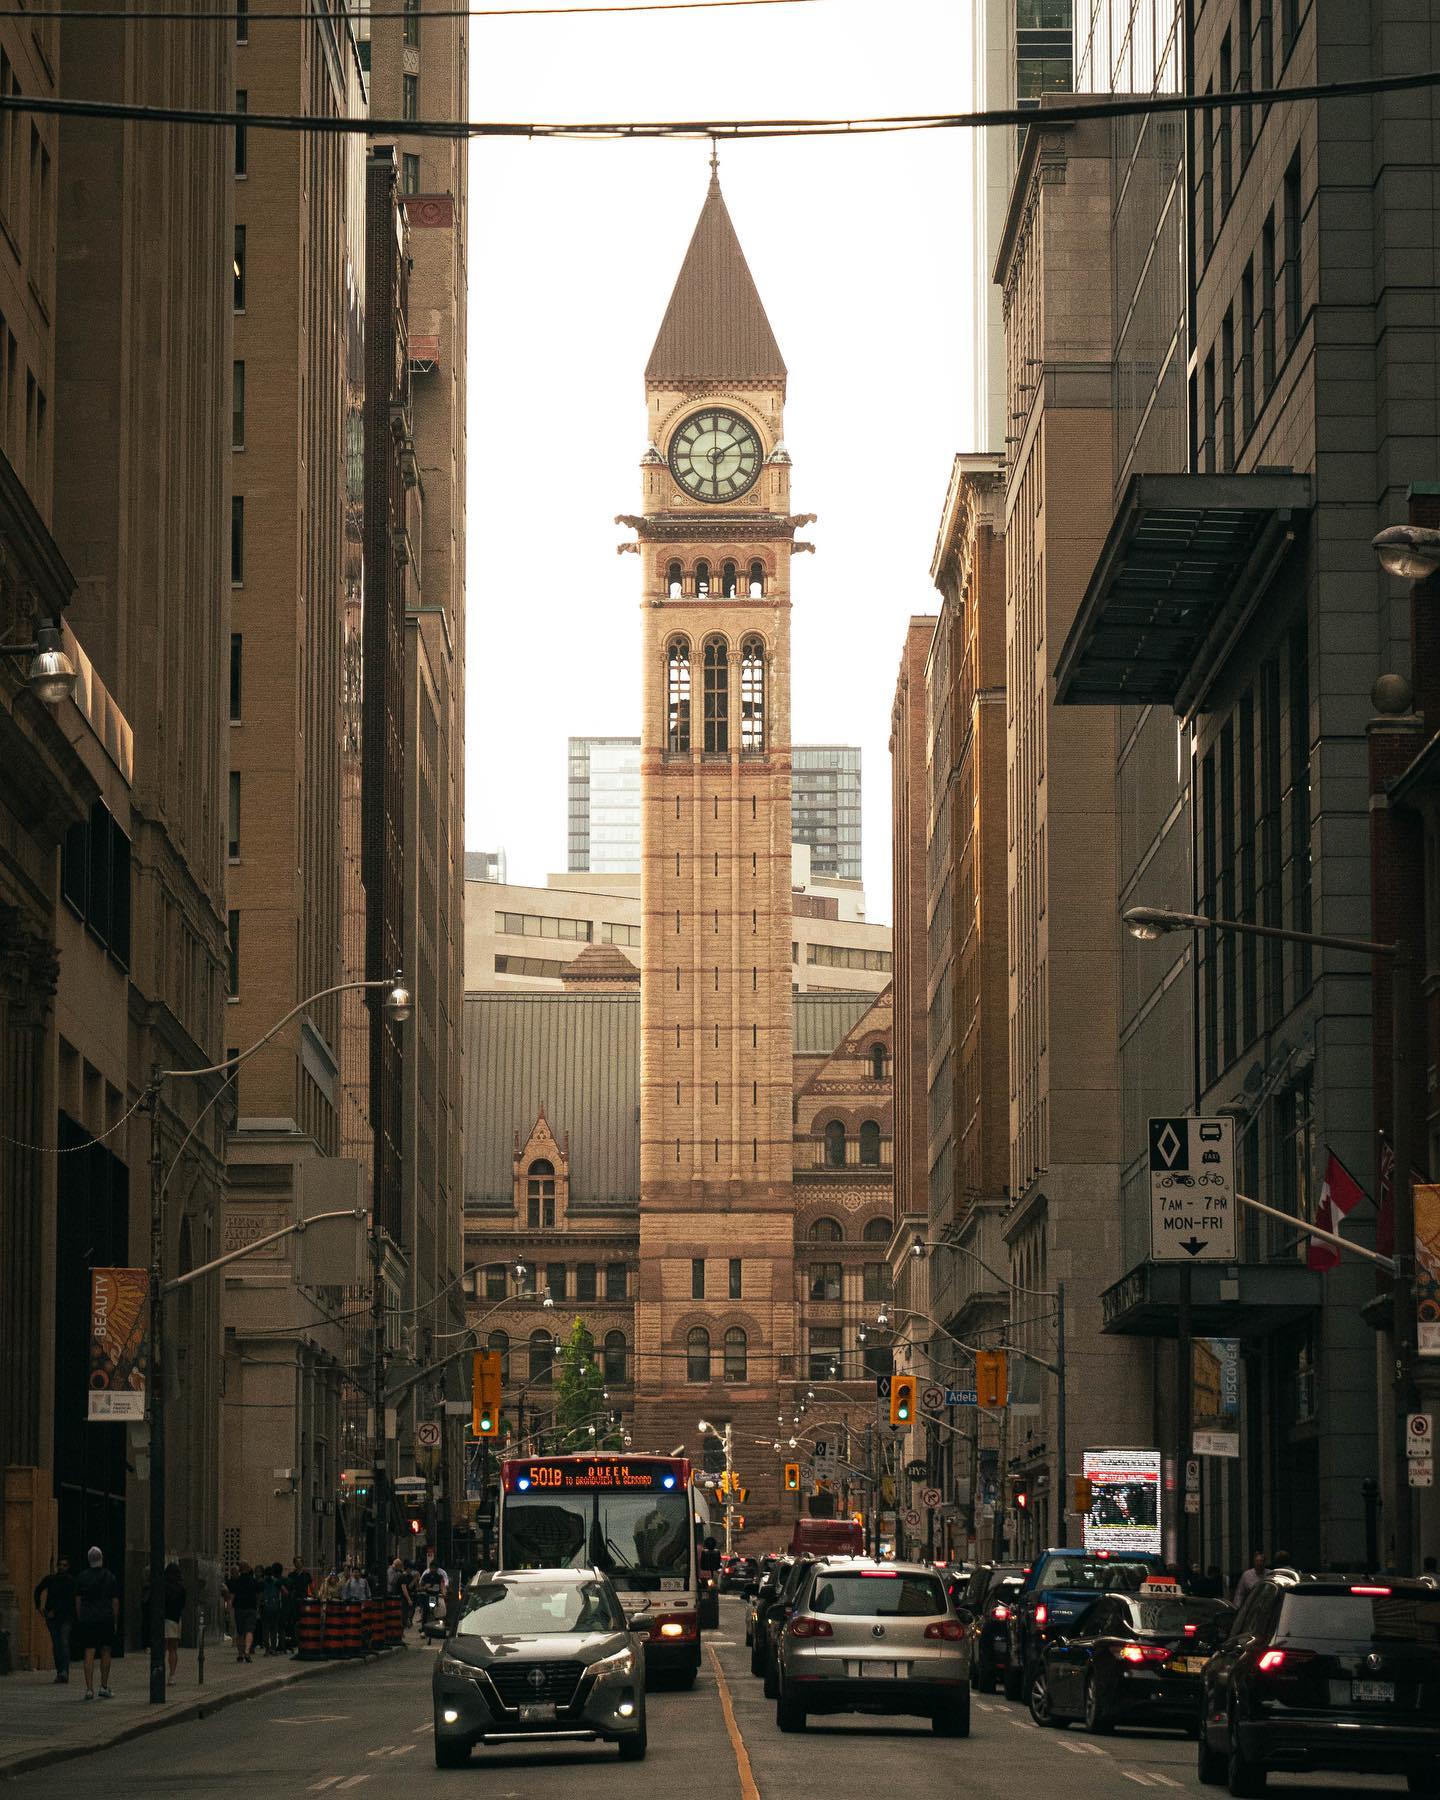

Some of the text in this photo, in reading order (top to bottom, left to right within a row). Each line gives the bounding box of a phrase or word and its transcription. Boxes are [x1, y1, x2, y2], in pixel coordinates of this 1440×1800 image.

[1163, 1217, 1223, 1230] MON-FRI
[95, 1276, 108, 1337] BEAUTY
[1227, 1343, 1237, 1404] DISCOVER
[530, 1466, 629, 1486] 501B QUEEN
[1148, 1585, 1177, 1593] TAXI
